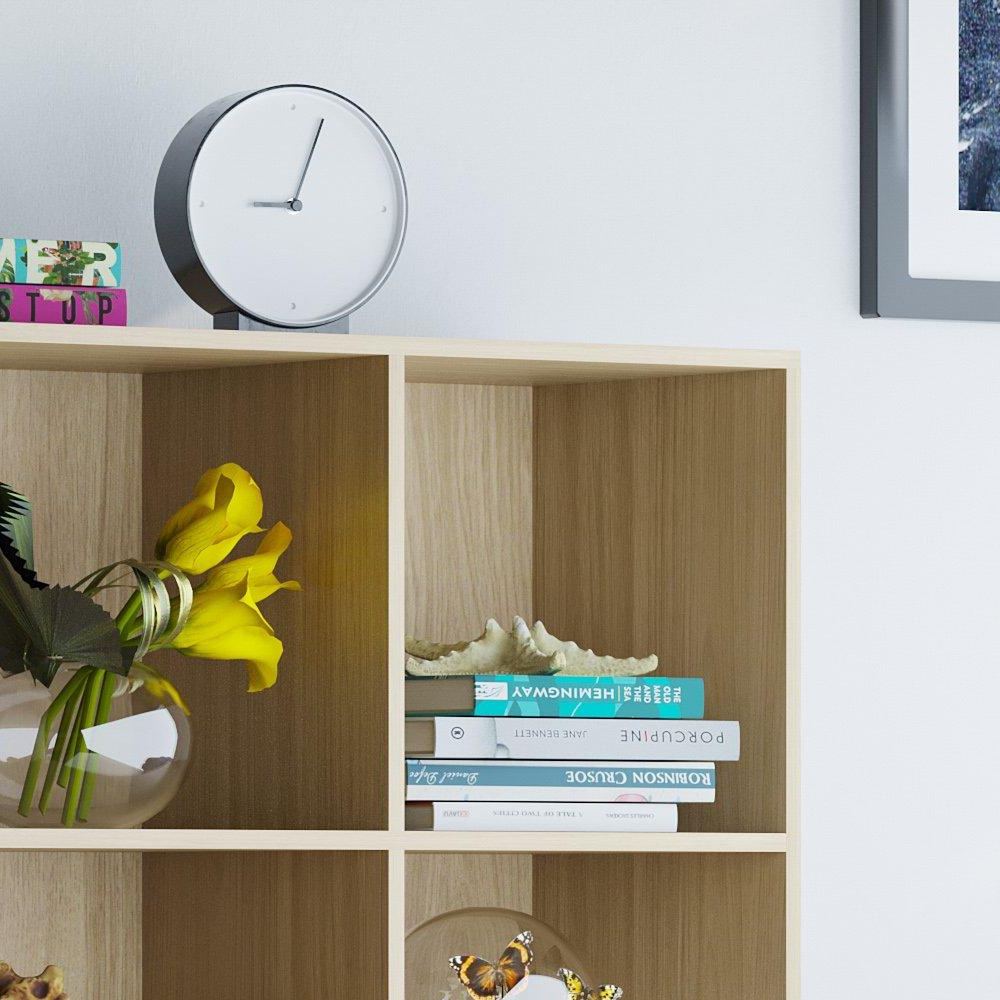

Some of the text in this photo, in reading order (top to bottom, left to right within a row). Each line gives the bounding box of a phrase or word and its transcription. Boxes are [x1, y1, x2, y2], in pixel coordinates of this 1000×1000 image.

[511, 686, 615, 700] HEMINGWAY
[623, 686, 631, 702] SEA
[633, 686, 641, 702] THE
[643, 685, 651, 704] AND
[653, 685, 661, 704] MAN
[663, 686, 671, 704] OLD
[673, 686, 681, 704] THE
[514, 729, 588, 739] JANE BENNETT
[620, 729, 725, 744] PORCUPINE
[408, 768, 479, 784] Daniel Defoe
[565, 770, 712, 785] ROBINSON CRUSOE
